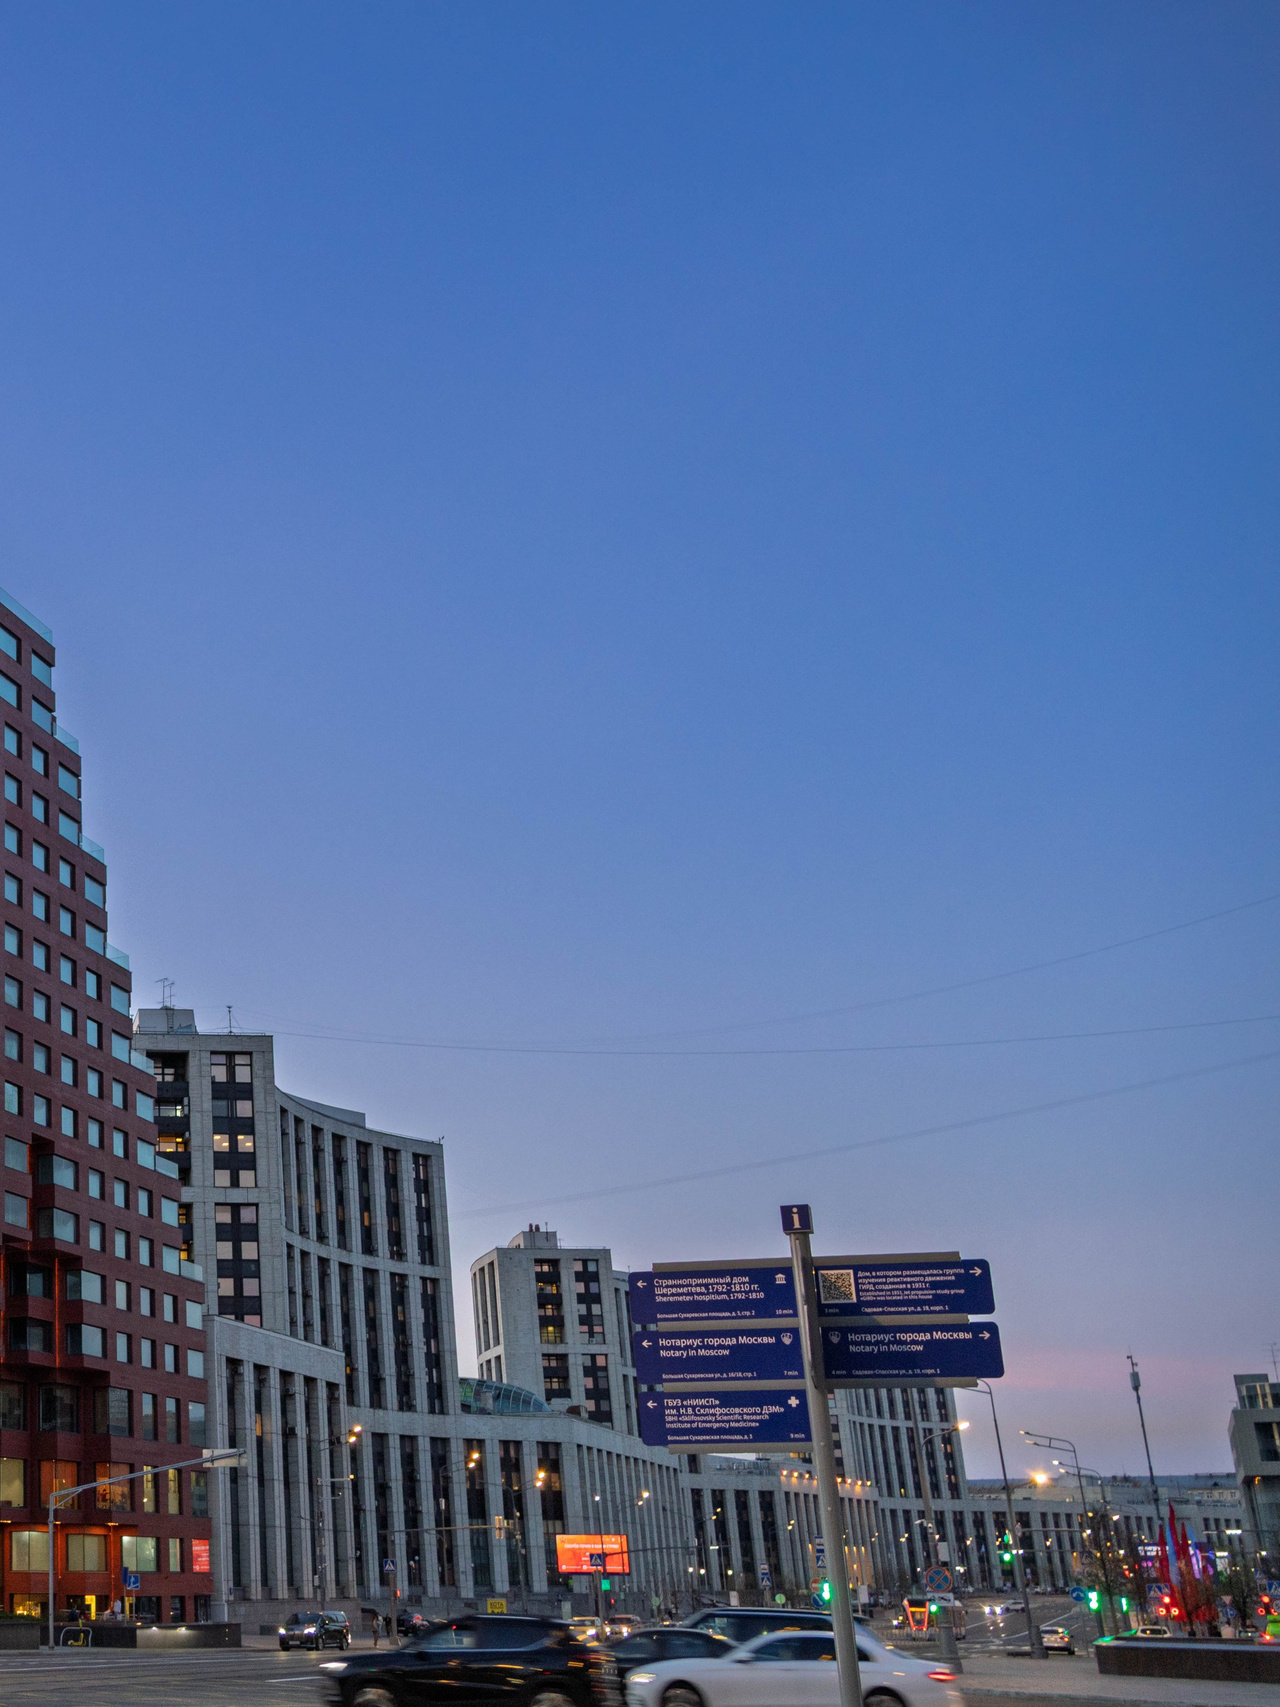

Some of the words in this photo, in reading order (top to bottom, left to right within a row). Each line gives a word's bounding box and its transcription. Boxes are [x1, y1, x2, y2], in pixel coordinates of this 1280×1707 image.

[654, 1276, 731, 1286] Странноприимный
[655, 1286, 707, 1294] Шереметева,
[708, 1284, 750, 1292] 1792-1810
[694, 1293, 729, 1301] hospitium,
[659, 1338, 702, 1347] Нотариус
[704, 1337, 736, 1346] города
[738, 1336, 775, 1344] Москвы
[848, 1332, 894, 1343] Нотариус
[896, 1331, 930, 1341] города
[933, 1331, 972, 1339] Москвы
[660, 1349, 687, 1358] Notary
[849, 1344, 878, 1353] Notary
[683, 1398, 720, 1406] «НИИСП»
[696, 1406, 760, 1416] Склифосовского
[762, 1406, 784, 1414] ДЗМ»
